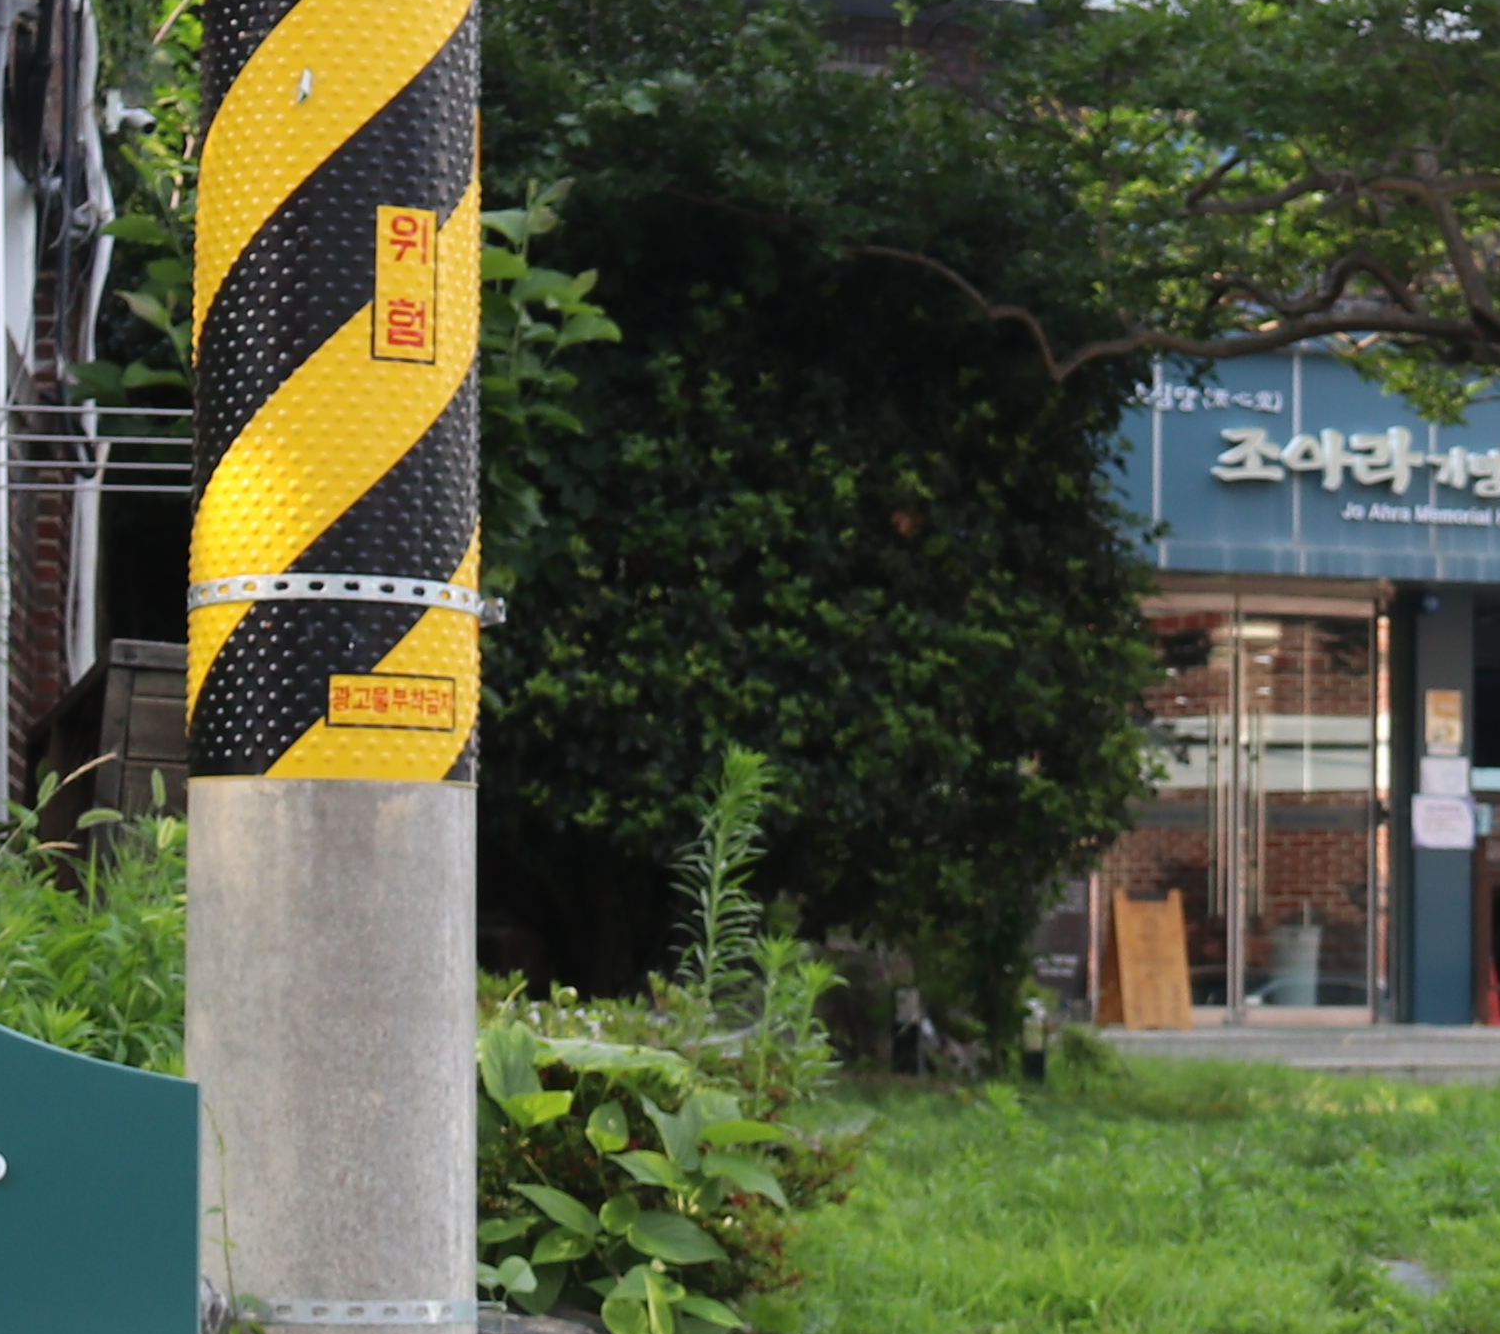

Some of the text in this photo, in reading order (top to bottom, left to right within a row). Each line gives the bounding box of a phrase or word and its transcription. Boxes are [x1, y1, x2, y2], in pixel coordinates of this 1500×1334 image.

[1210, 425, 1425, 495] 조아라
[1341, 501, 1364, 521] Jo
[1368, 503, 1411, 524] Ahra
[1414, 505, 1490, 527] Memorial
